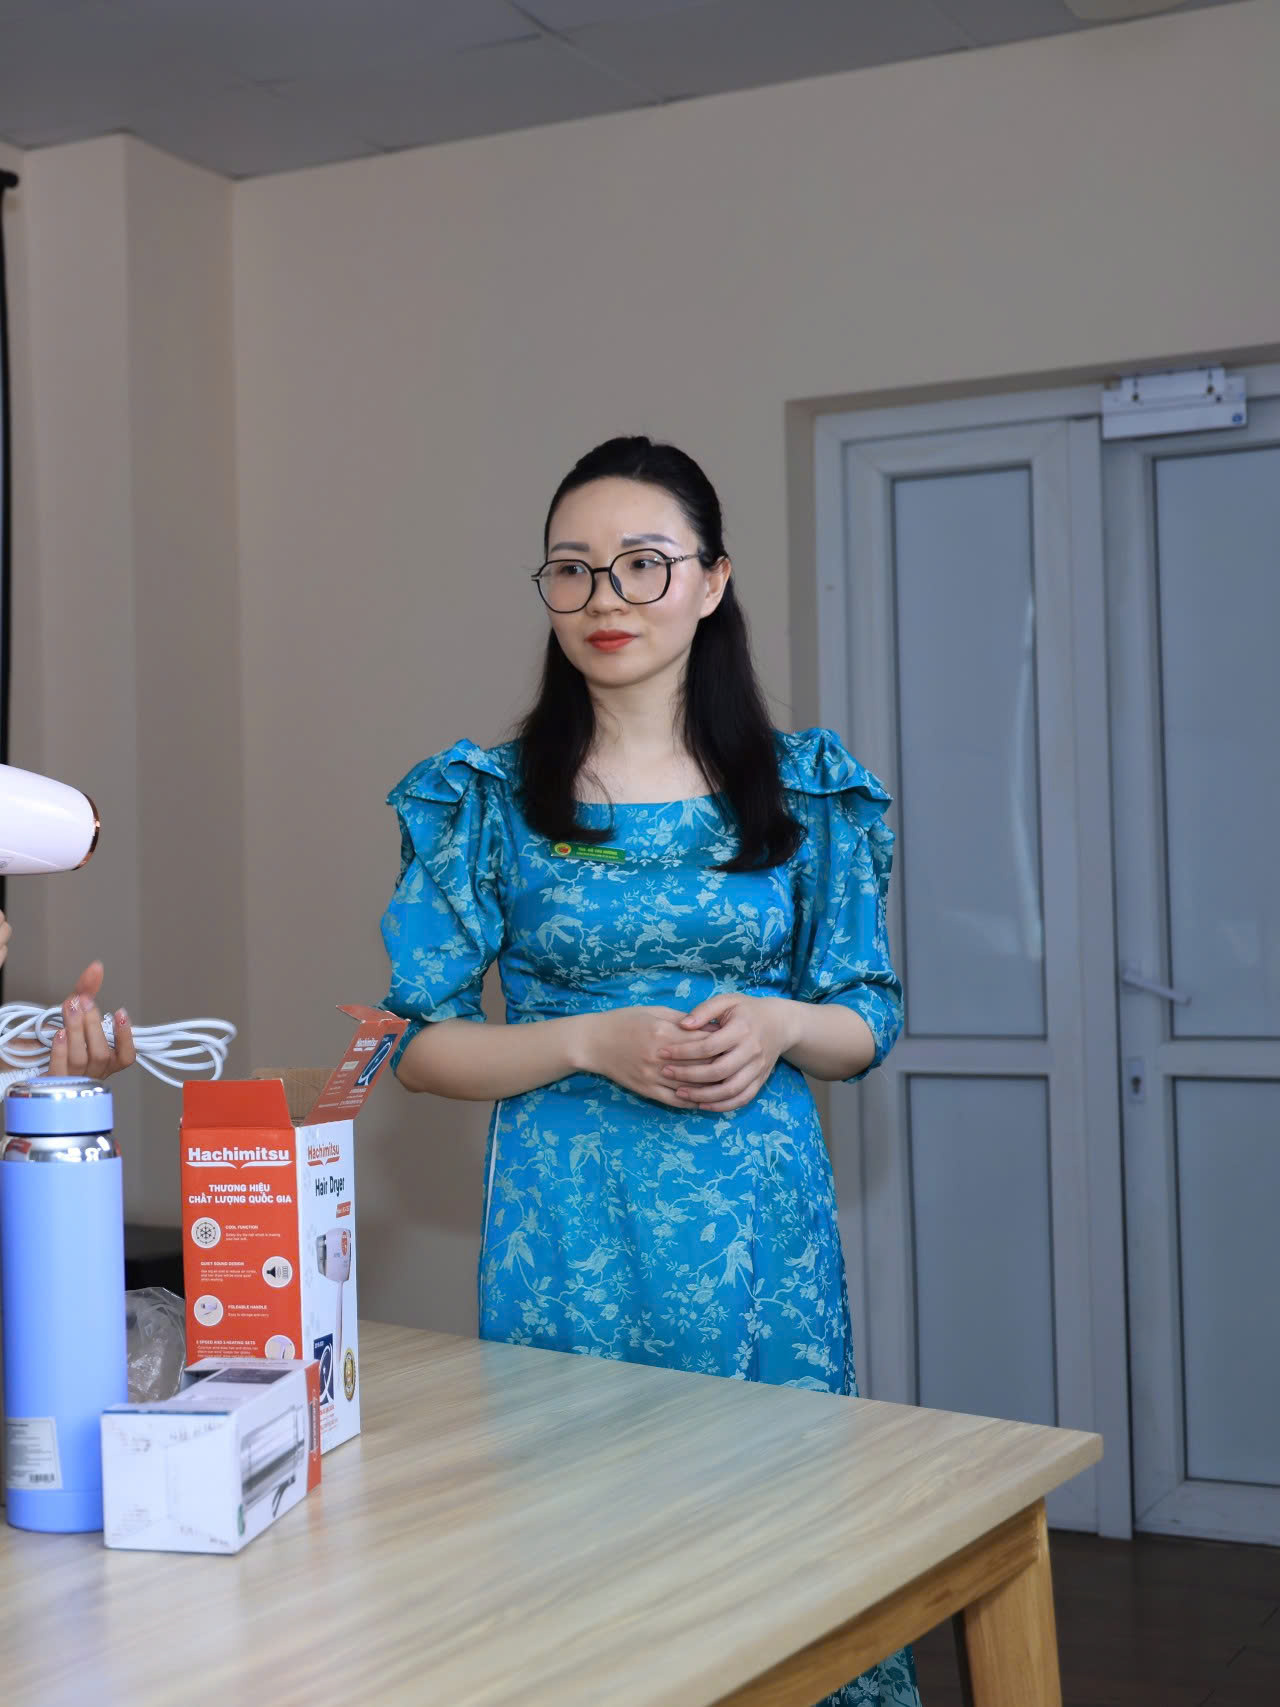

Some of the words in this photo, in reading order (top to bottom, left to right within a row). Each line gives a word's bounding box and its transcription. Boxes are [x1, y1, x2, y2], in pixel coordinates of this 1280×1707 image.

[187, 1146, 290, 1161] Hachimitsu
[307, 1142, 340, 1161] Hachimitsu
[208, 1183, 247, 1193] THƯƠNG
[315, 1177, 328, 1197] Hair
[329, 1175, 345, 1198] Dryer
[214, 1194, 246, 1205] LƯỢNG
[276, 1194, 293, 1204] GIA
